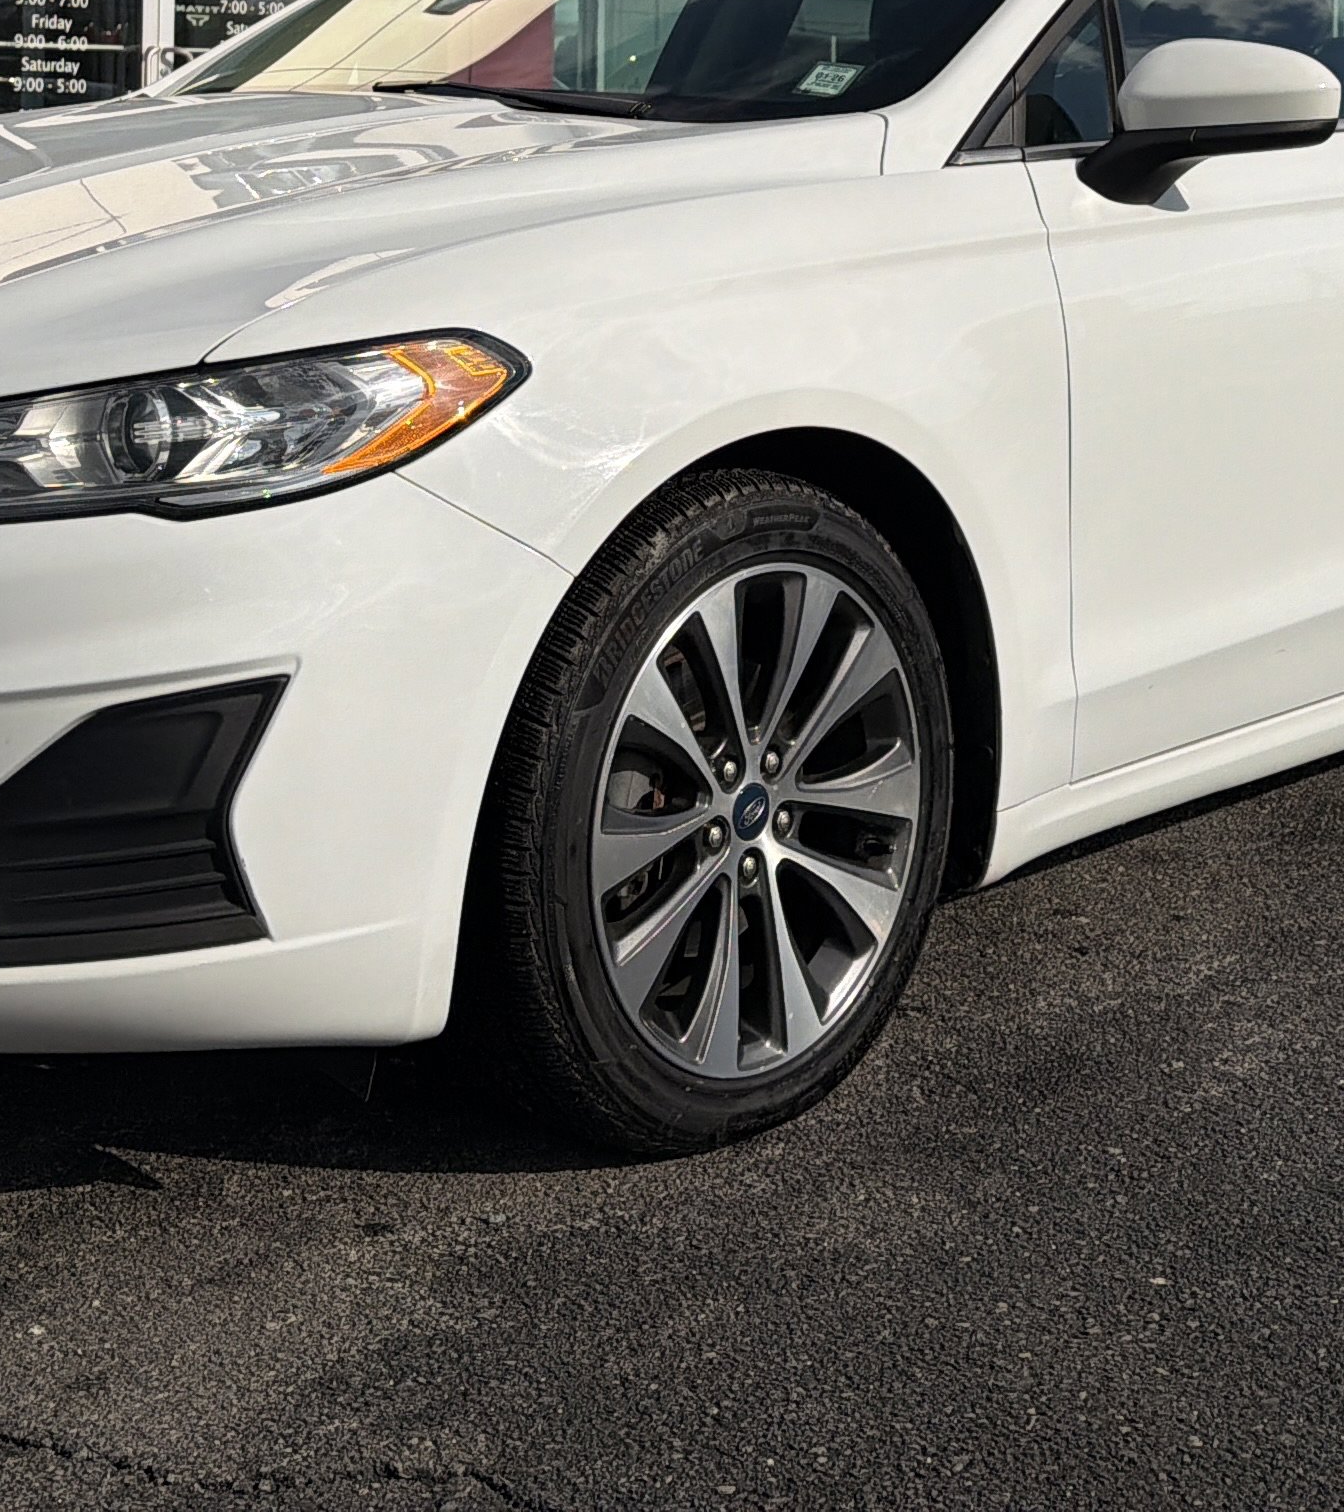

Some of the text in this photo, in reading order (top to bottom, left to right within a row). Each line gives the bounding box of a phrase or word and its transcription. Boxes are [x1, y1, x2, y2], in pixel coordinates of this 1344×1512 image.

[220, 0, 248, 14] 7:00
[31, 13, 73, 33] Friday
[13, 33, 46, 49] 9:00
[21, 55, 80, 76] Saturday
[12, 76, 44, 92] 9:00
[56, 78, 87, 94] 5:00
[595, 537, 705, 681] BRIDGESTONE
